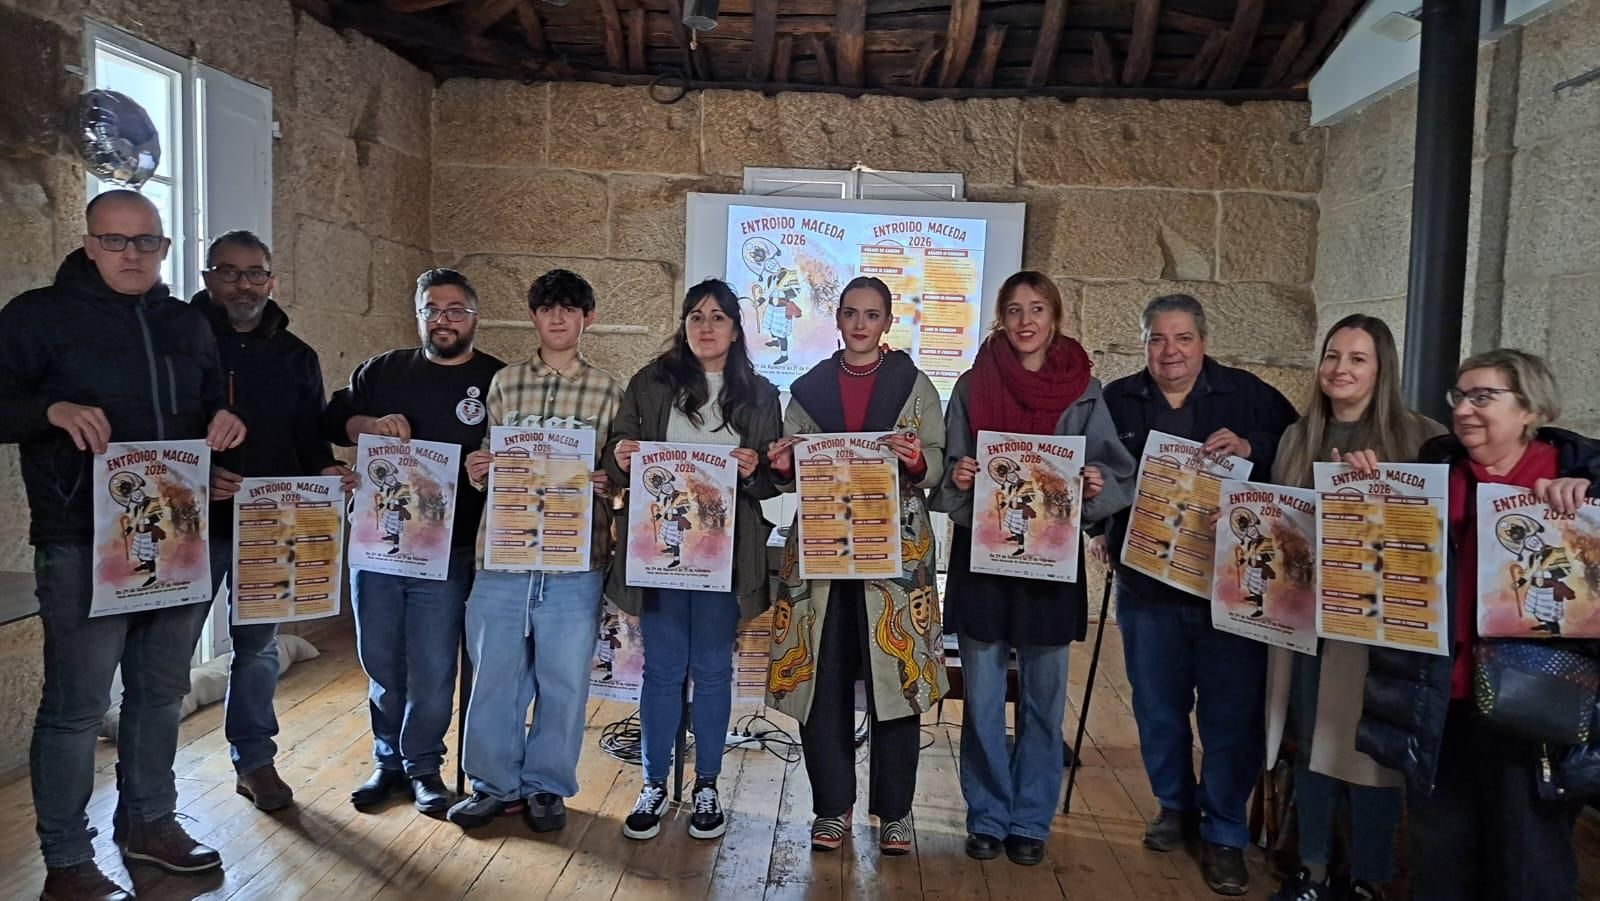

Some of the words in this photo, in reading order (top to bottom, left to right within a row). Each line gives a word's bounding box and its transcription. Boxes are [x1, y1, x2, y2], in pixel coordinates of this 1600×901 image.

[741, 217, 795, 234] ENTROIDO
[802, 218, 845, 240] MACEDA
[873, 221, 922, 238] ENTROIDO
[928, 222, 967, 242] MACEDA
[780, 234, 806, 245] 2026
[909, 236, 932, 247] 2026
[504, 432, 544, 446] ENTROIDO
[548, 433, 579, 449] MACEDA
[807, 438, 845, 454] ENTROIDO
[850, 438, 881, 453] MACEDA
[368, 445, 410, 457] ENTROIDO
[415, 447, 449, 465] MACEDA
[533, 444, 551, 452] 2026
[835, 450, 854, 458] 2026
[987, 441, 1033, 455] ENTROIDO
[1038, 442, 1074, 460] MACEDA
[1159, 443, 1200, 457] ENTROIDO
[107, 450, 157, 471] ENTROIDO
[162, 449, 200, 466] MACEDA
[398, 457, 418, 467] 2026
[642, 450, 687, 465] ENTROIDO
[692, 451, 727, 469] MACEDA
[1020, 454, 1041, 464] 2026
[145, 464, 167, 475] 2026
[675, 464, 695, 473] 2026
[1331, 469, 1380, 486] ENTROIDO
[1386, 469, 1426, 490] MACEDA
[249, 482, 292, 497] ENTROIDO
[296, 482, 330, 495] MACEDA
[1368, 484, 1391, 494] 2026
[281, 493, 301, 502] 2026
[1229, 491, 1274, 505] ENTROIDO
[1279, 493, 1316, 517] MACEDA
[1260, 506, 1281, 518] 2026
